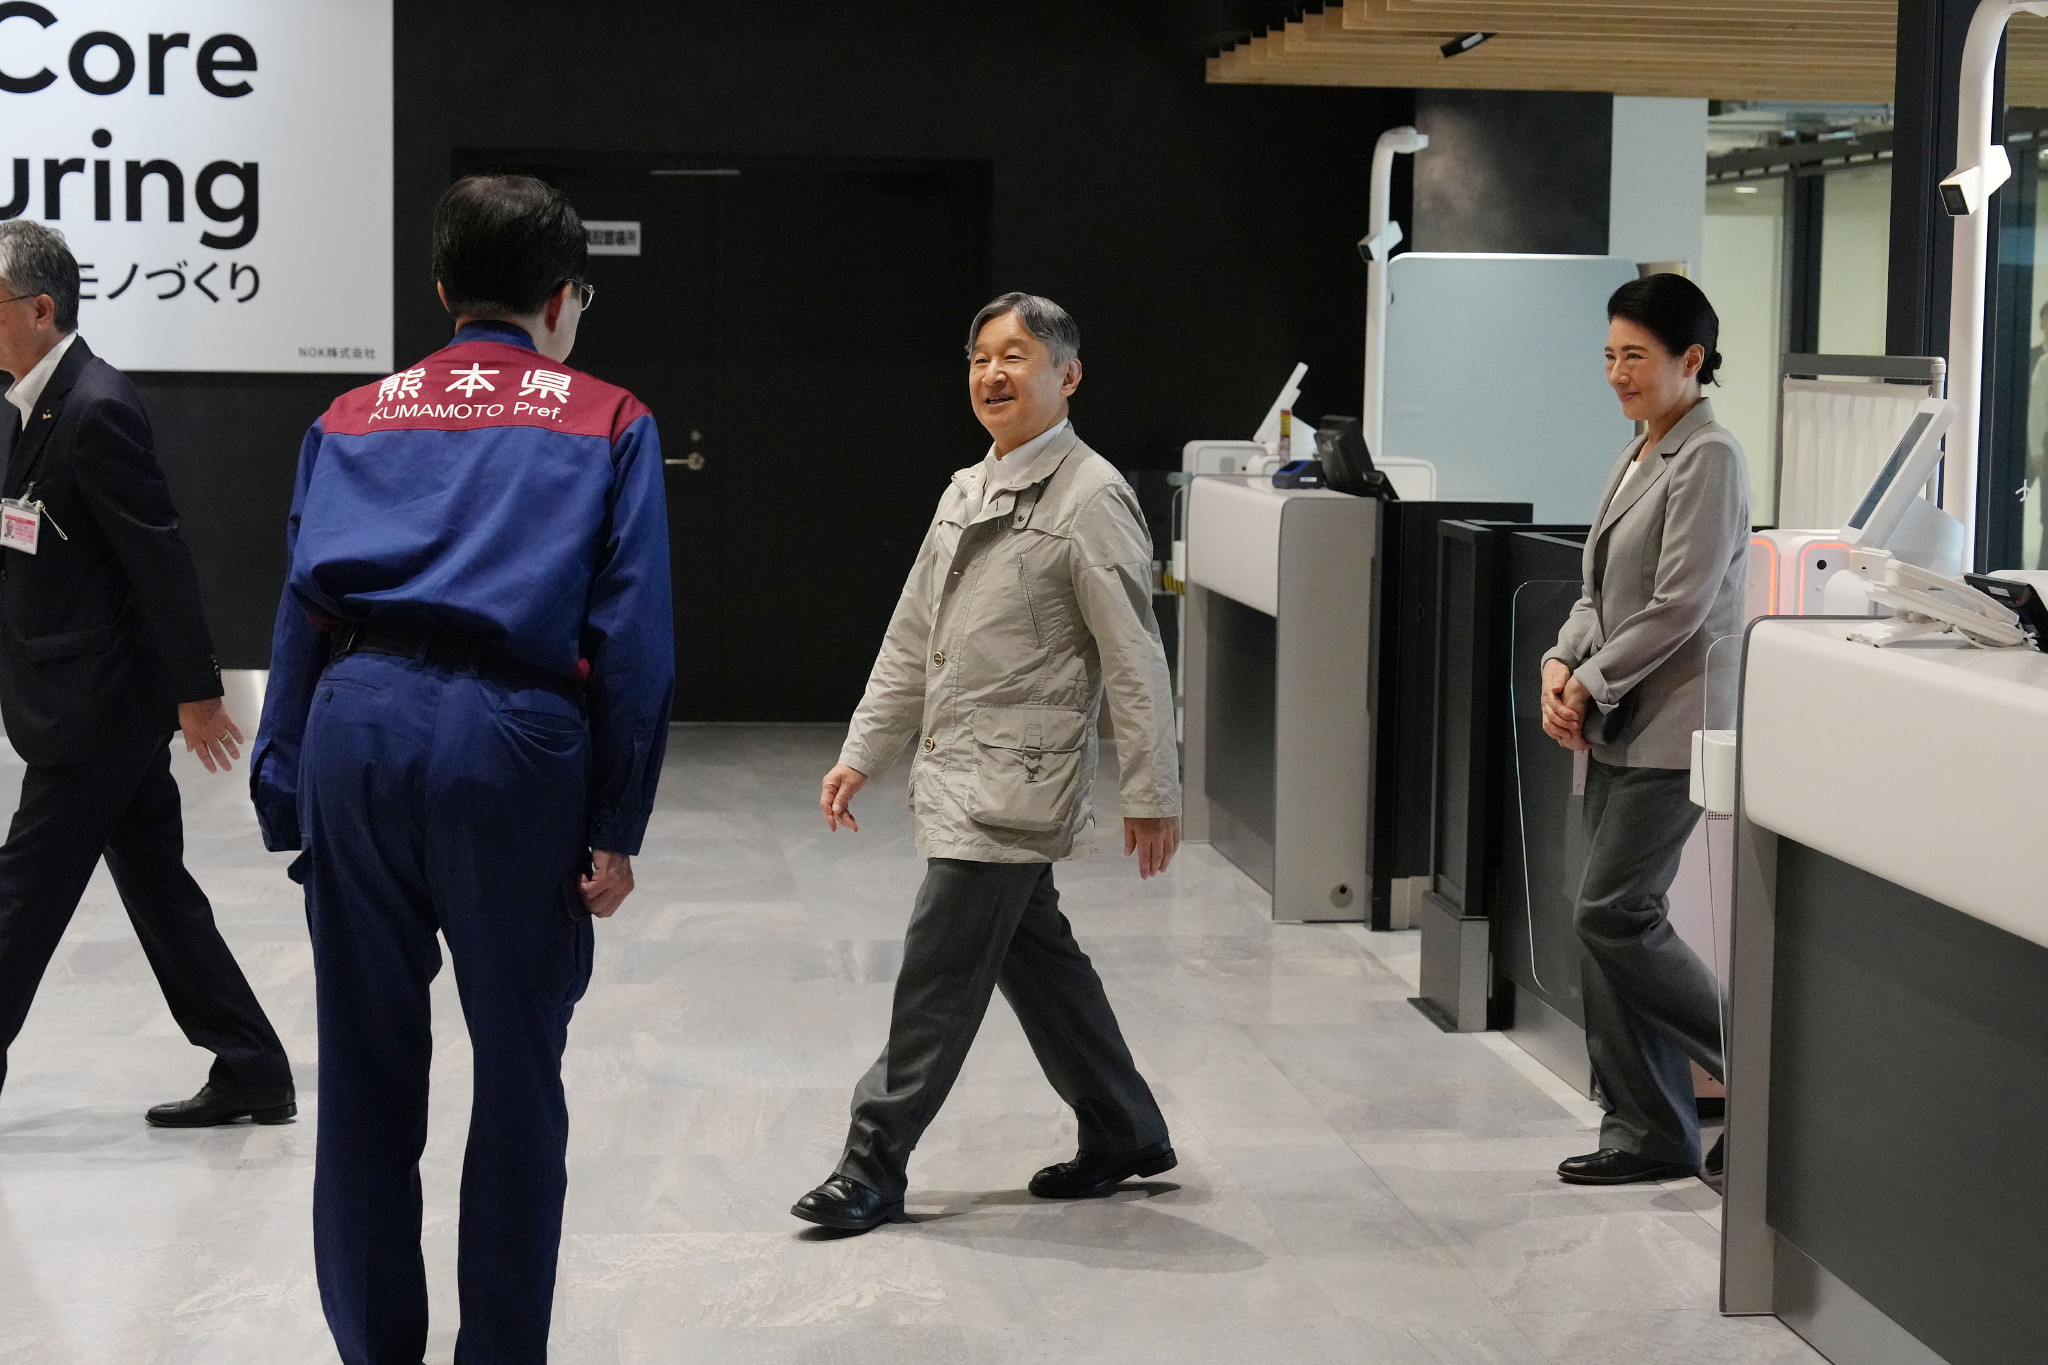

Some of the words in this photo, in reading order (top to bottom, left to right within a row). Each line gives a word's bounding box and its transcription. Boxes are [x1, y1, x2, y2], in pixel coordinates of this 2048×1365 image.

[0, 1, 258, 98] Core
[375, 362, 572, 407] 熊本県
[368, 403, 504, 424] KUMAMOTO
[513, 401, 563, 423] Pref.
